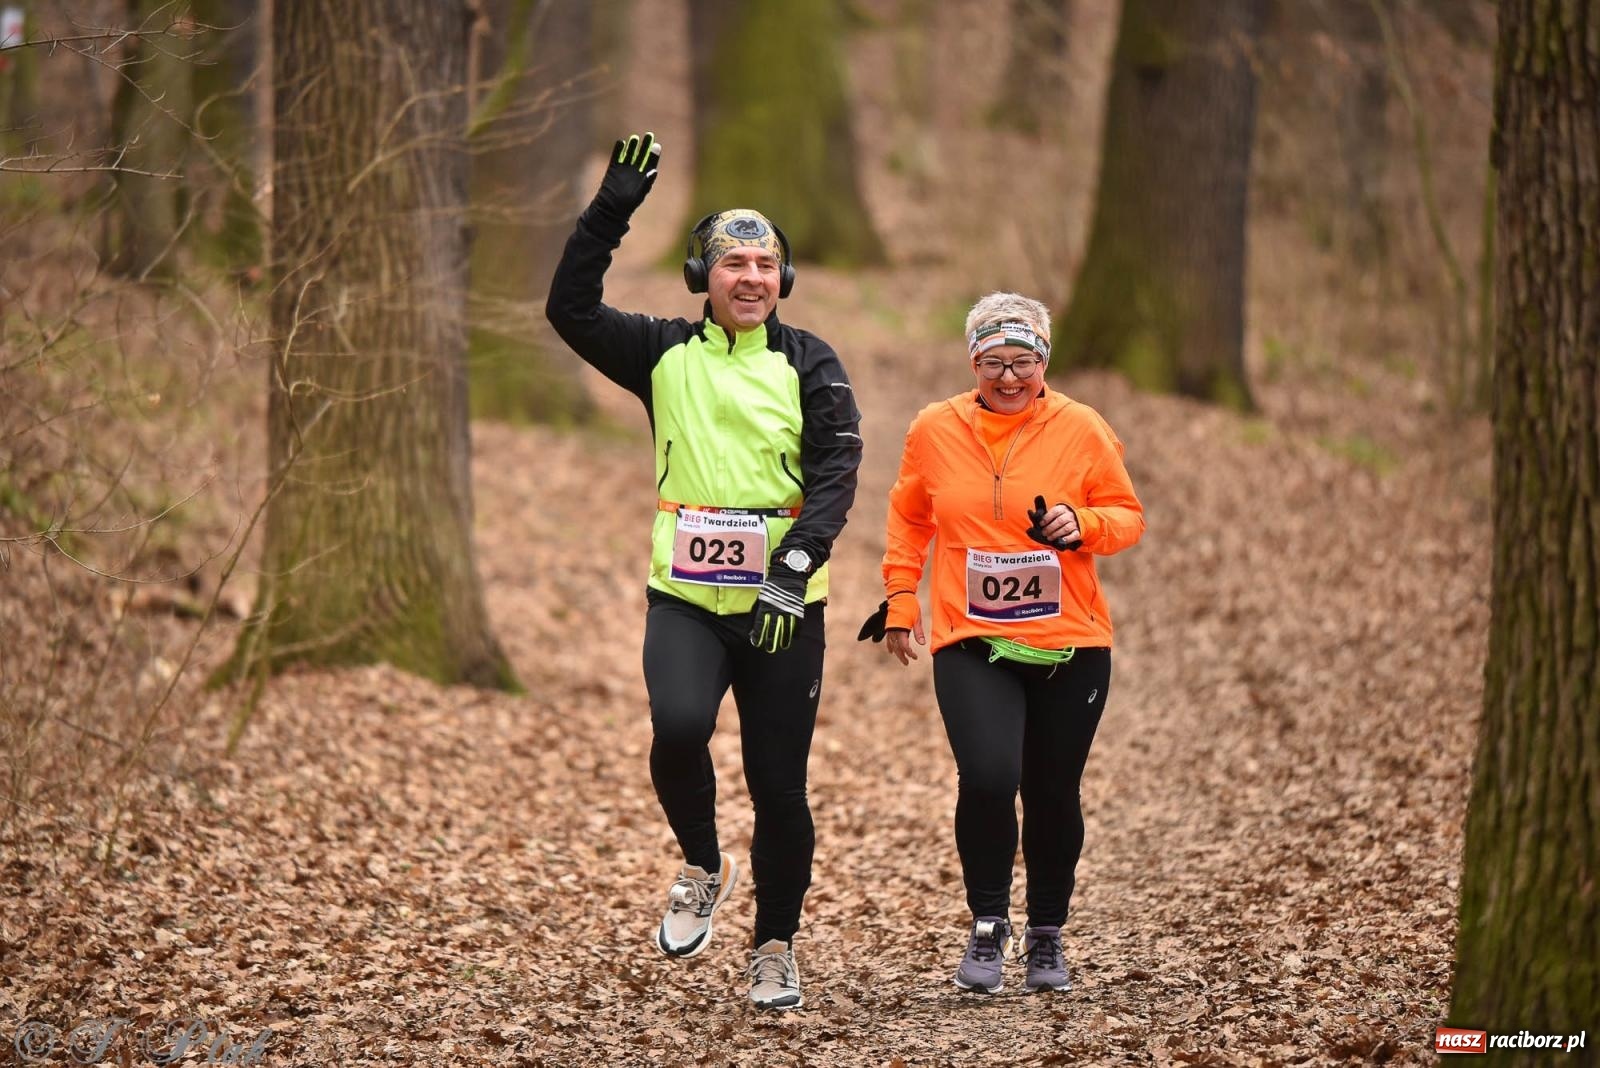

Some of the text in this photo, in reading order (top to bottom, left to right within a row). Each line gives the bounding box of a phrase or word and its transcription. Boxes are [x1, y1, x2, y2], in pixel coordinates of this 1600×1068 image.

[703, 516, 758, 528] Twardziela
[689, 536, 745, 566] 023
[973, 553, 1051, 564] BIEG Twardziela
[982, 575, 1042, 601] 024
